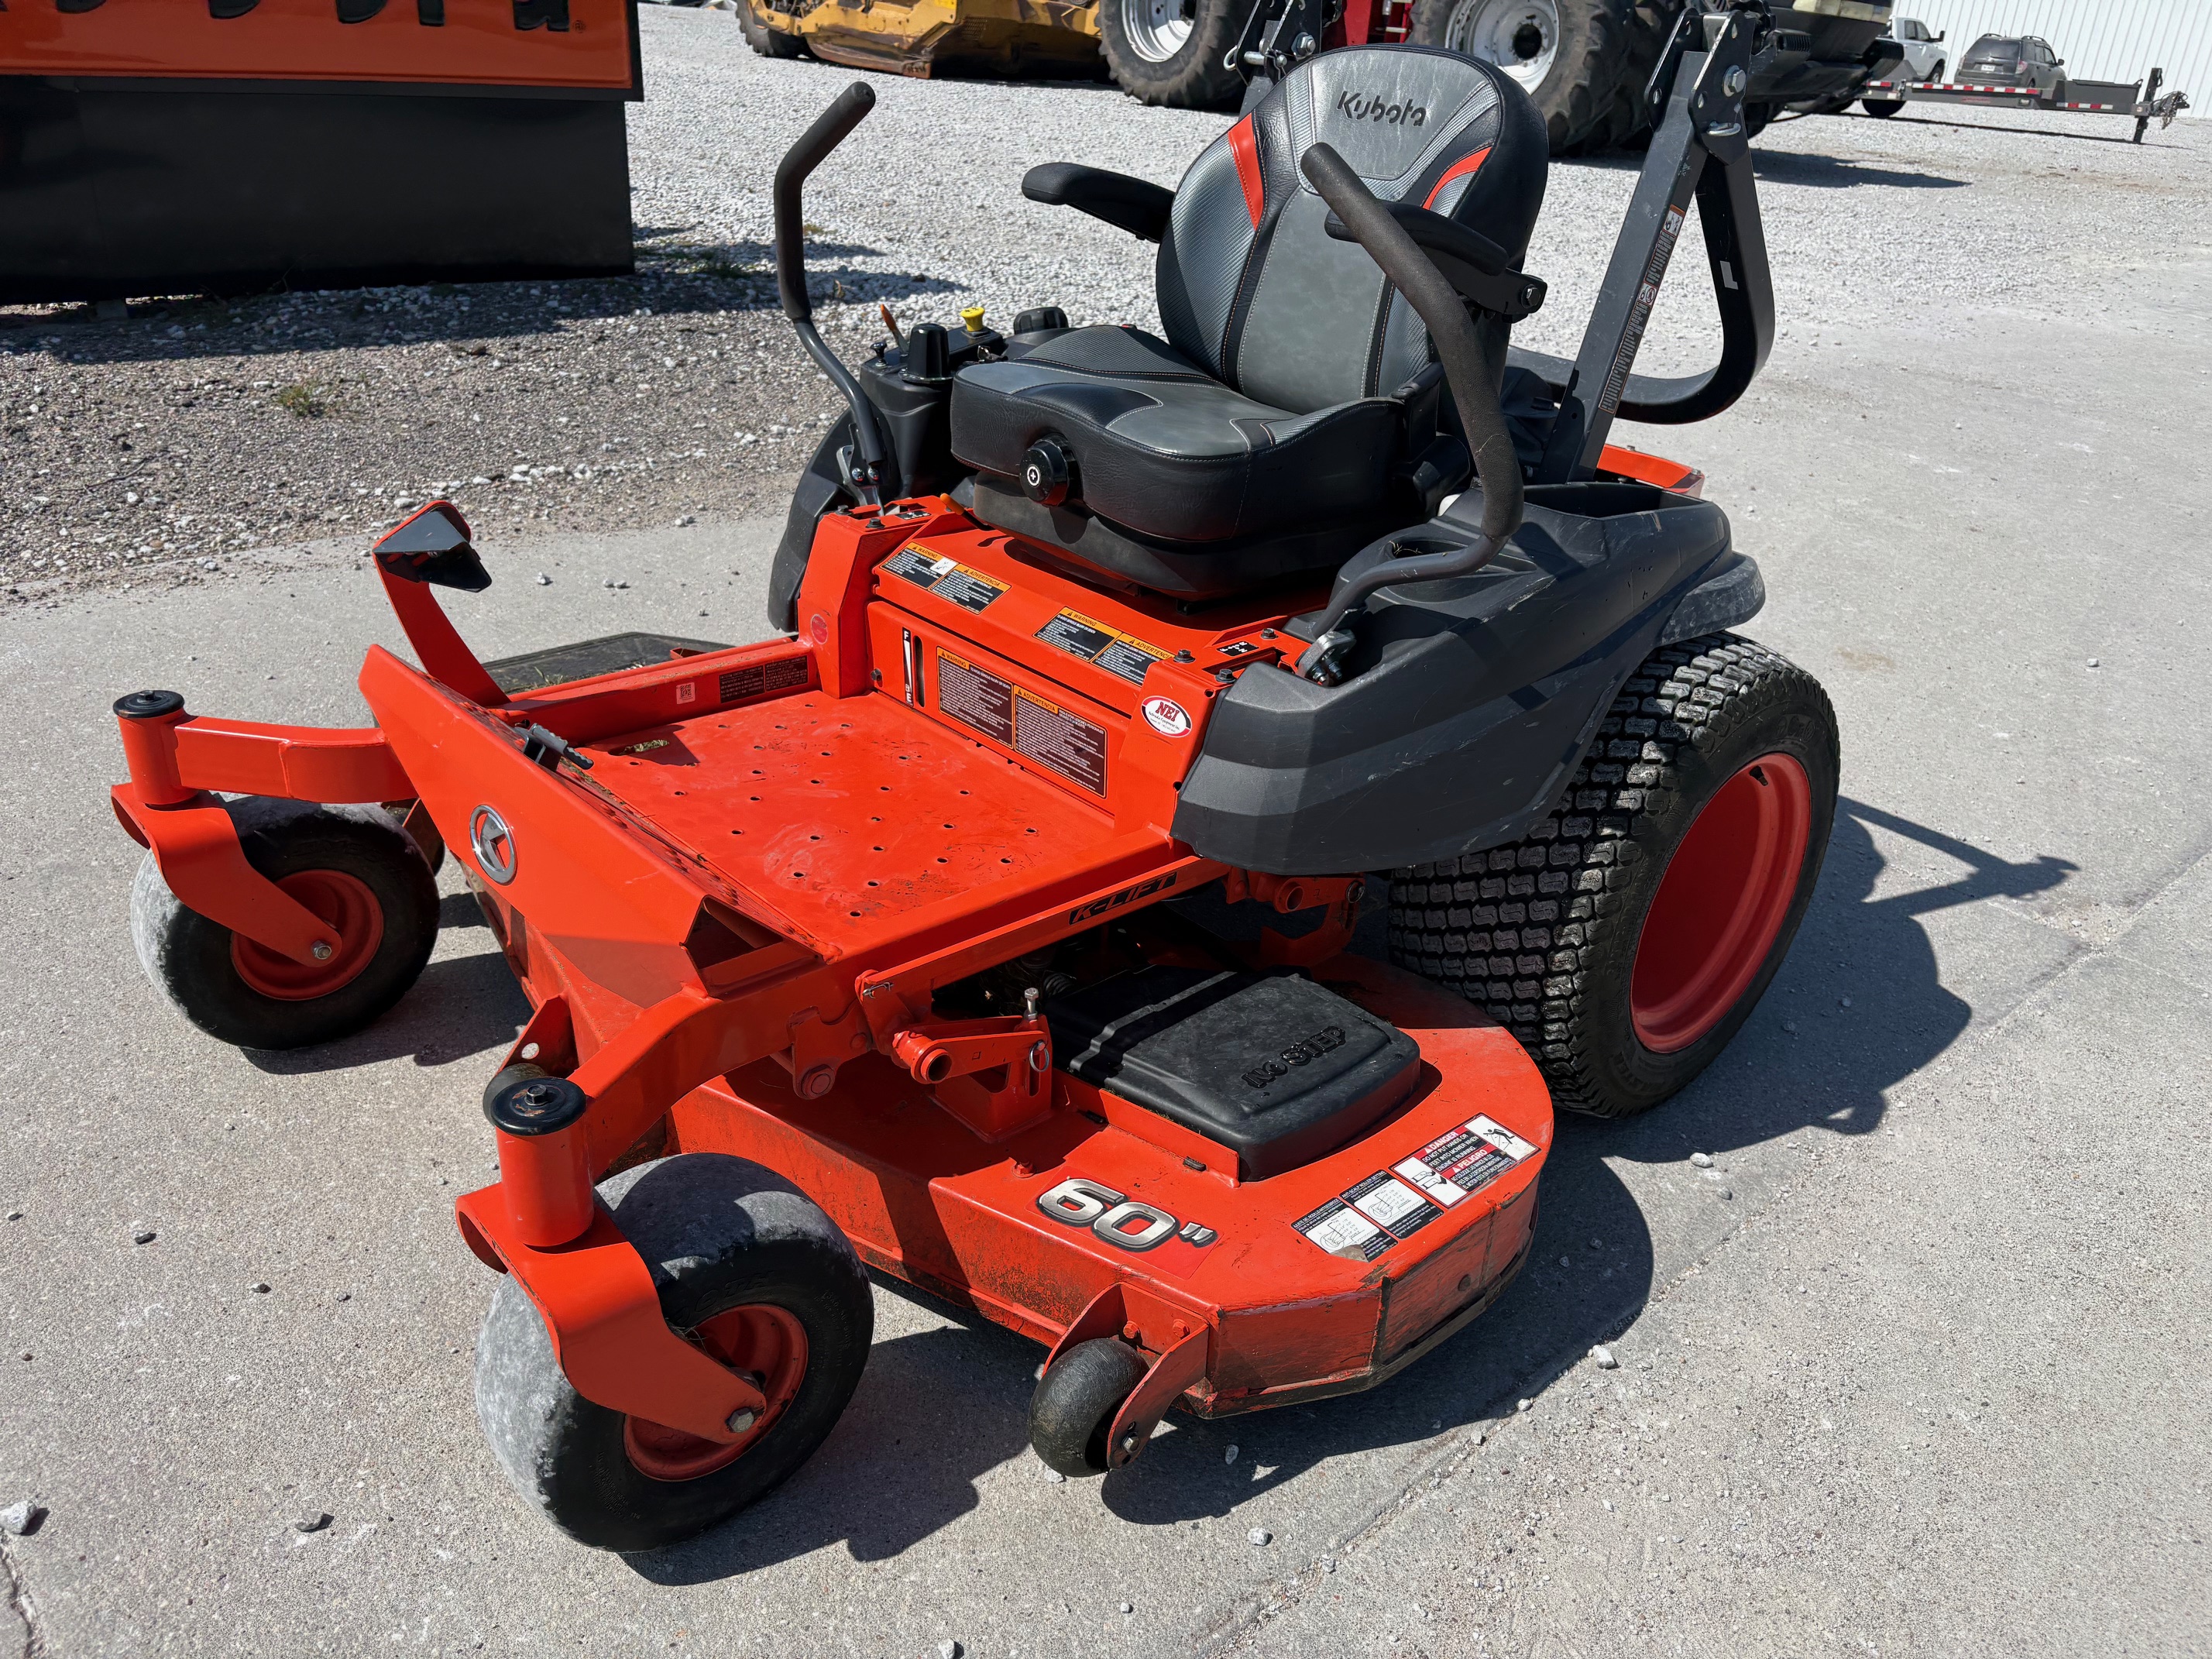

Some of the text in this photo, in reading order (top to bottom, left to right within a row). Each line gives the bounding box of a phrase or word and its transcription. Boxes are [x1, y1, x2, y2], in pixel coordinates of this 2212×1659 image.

[1337, 91, 1427, 126] Kubota
[969, 570, 1001, 587] ADVERTENCIA
[1073, 613, 1097, 627] WARNING
[904, 630, 909, 640] F
[946, 652, 967, 668] WARNING
[906, 692, 912, 702] E
[1023, 692, 1056, 712] ADVERTENCIA
[1155, 701, 1180, 722] NEI
[1072, 873, 1176, 923] K-LIFT
[1242, 1025, 1346, 1089] NO STEP
[1428, 1131, 1459, 1150] DANGER
[1446, 1137, 1462, 1148] HANDS
[1428, 1158, 1441, 1167] FEET
[1448, 1142, 1467, 1155] MOWER
[1464, 1135, 1479, 1146] WHEN
[1458, 1149, 1488, 1170] PELIGRO
[1435, 1159, 1453, 1172] ENGINE
